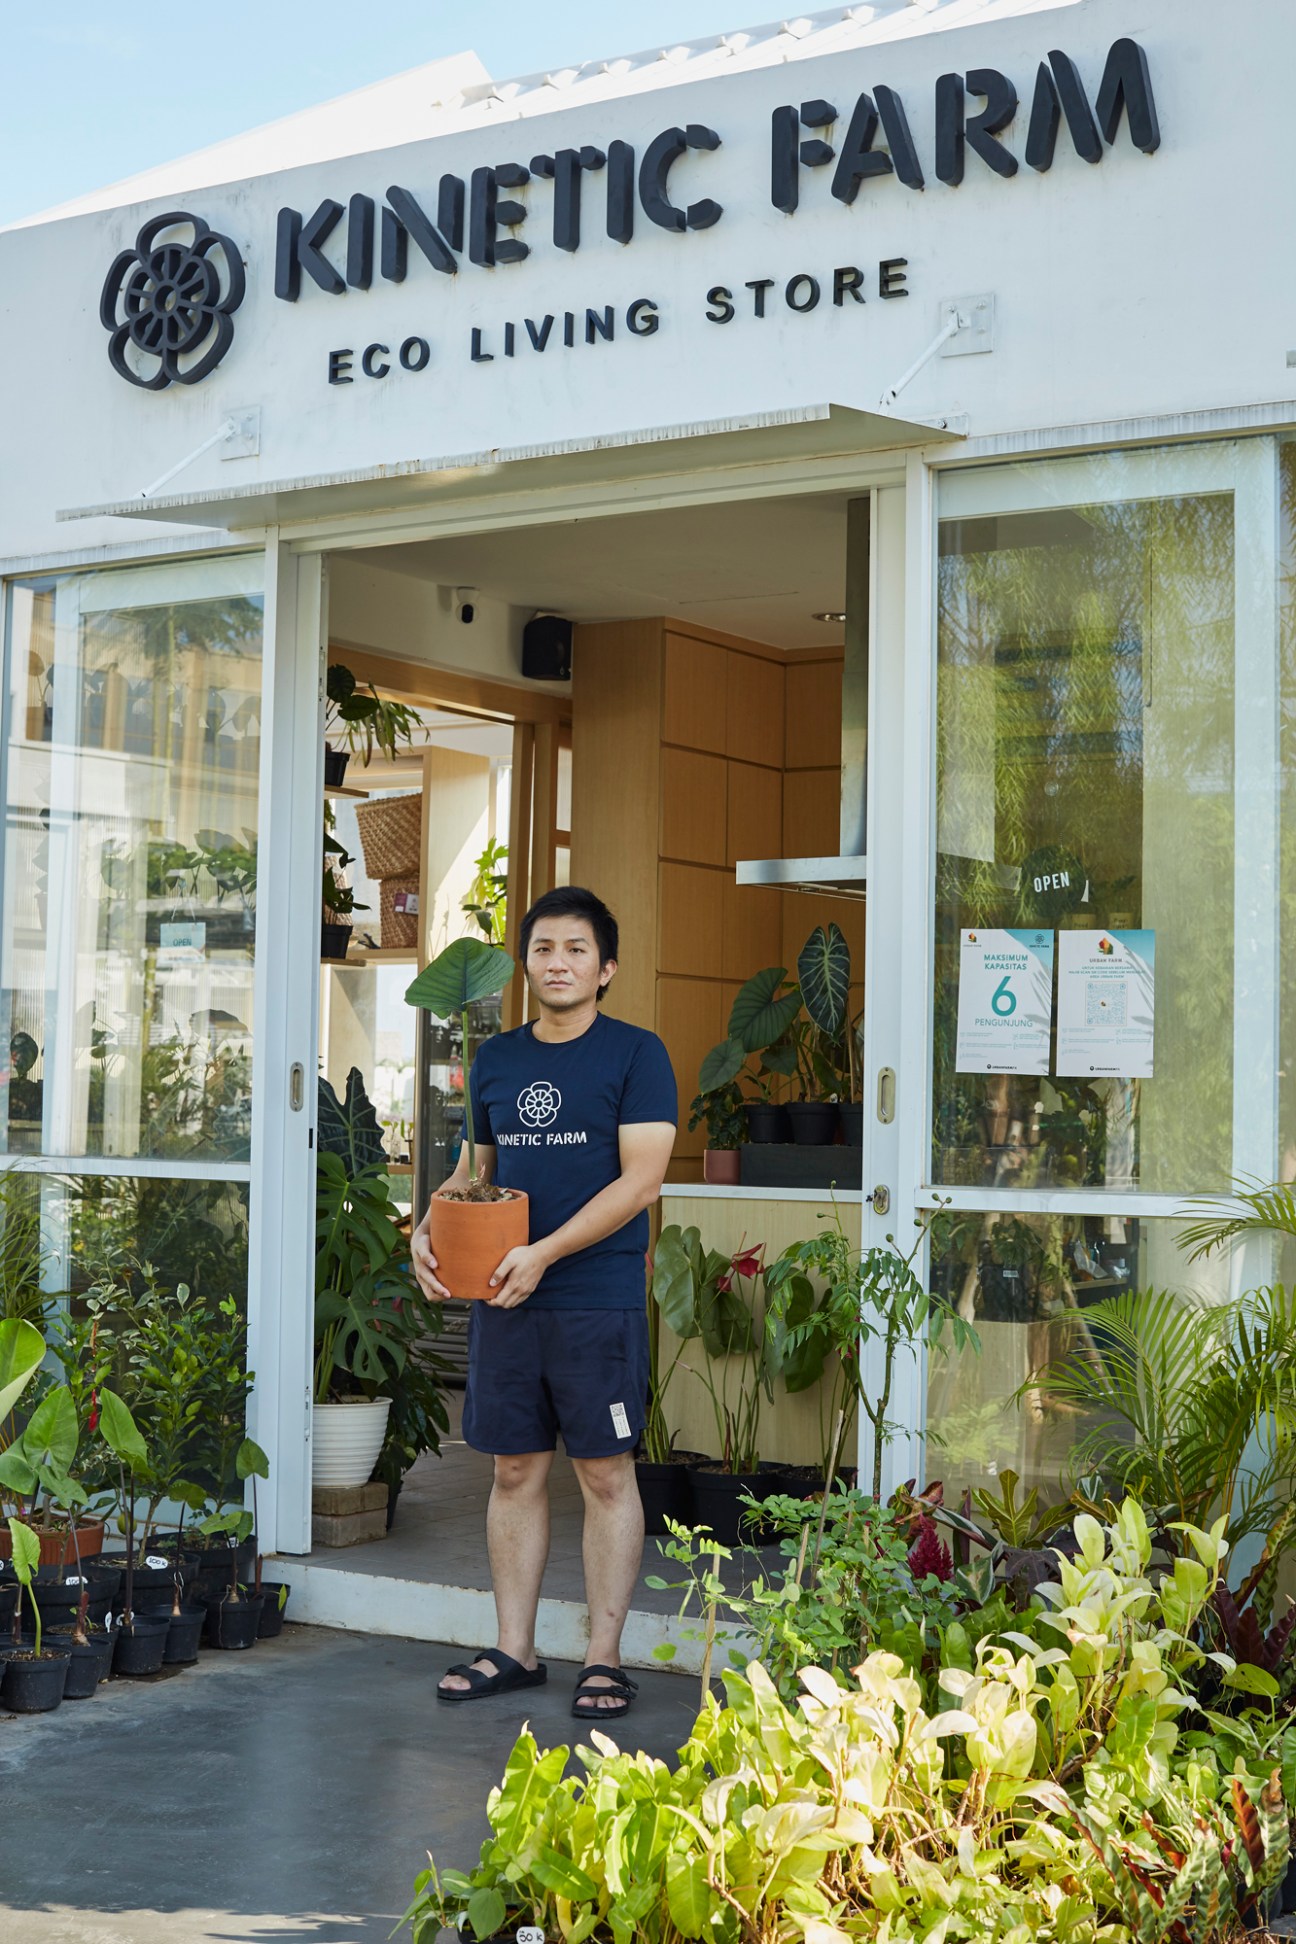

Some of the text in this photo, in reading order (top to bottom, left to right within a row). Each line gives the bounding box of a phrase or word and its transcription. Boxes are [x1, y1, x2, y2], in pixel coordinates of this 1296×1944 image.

[274, 37, 1161, 302] KINETIC FARM
[328, 257, 909, 385] ECO LIVING STORE
[1033, 871, 1070, 893] OPEN
[172, 938, 192, 947] OPEN
[991, 975, 1017, 1017] 6
[974, 1018, 1033, 1028] PENGUNJUNG
[546, 1131, 587, 1145] FARM
